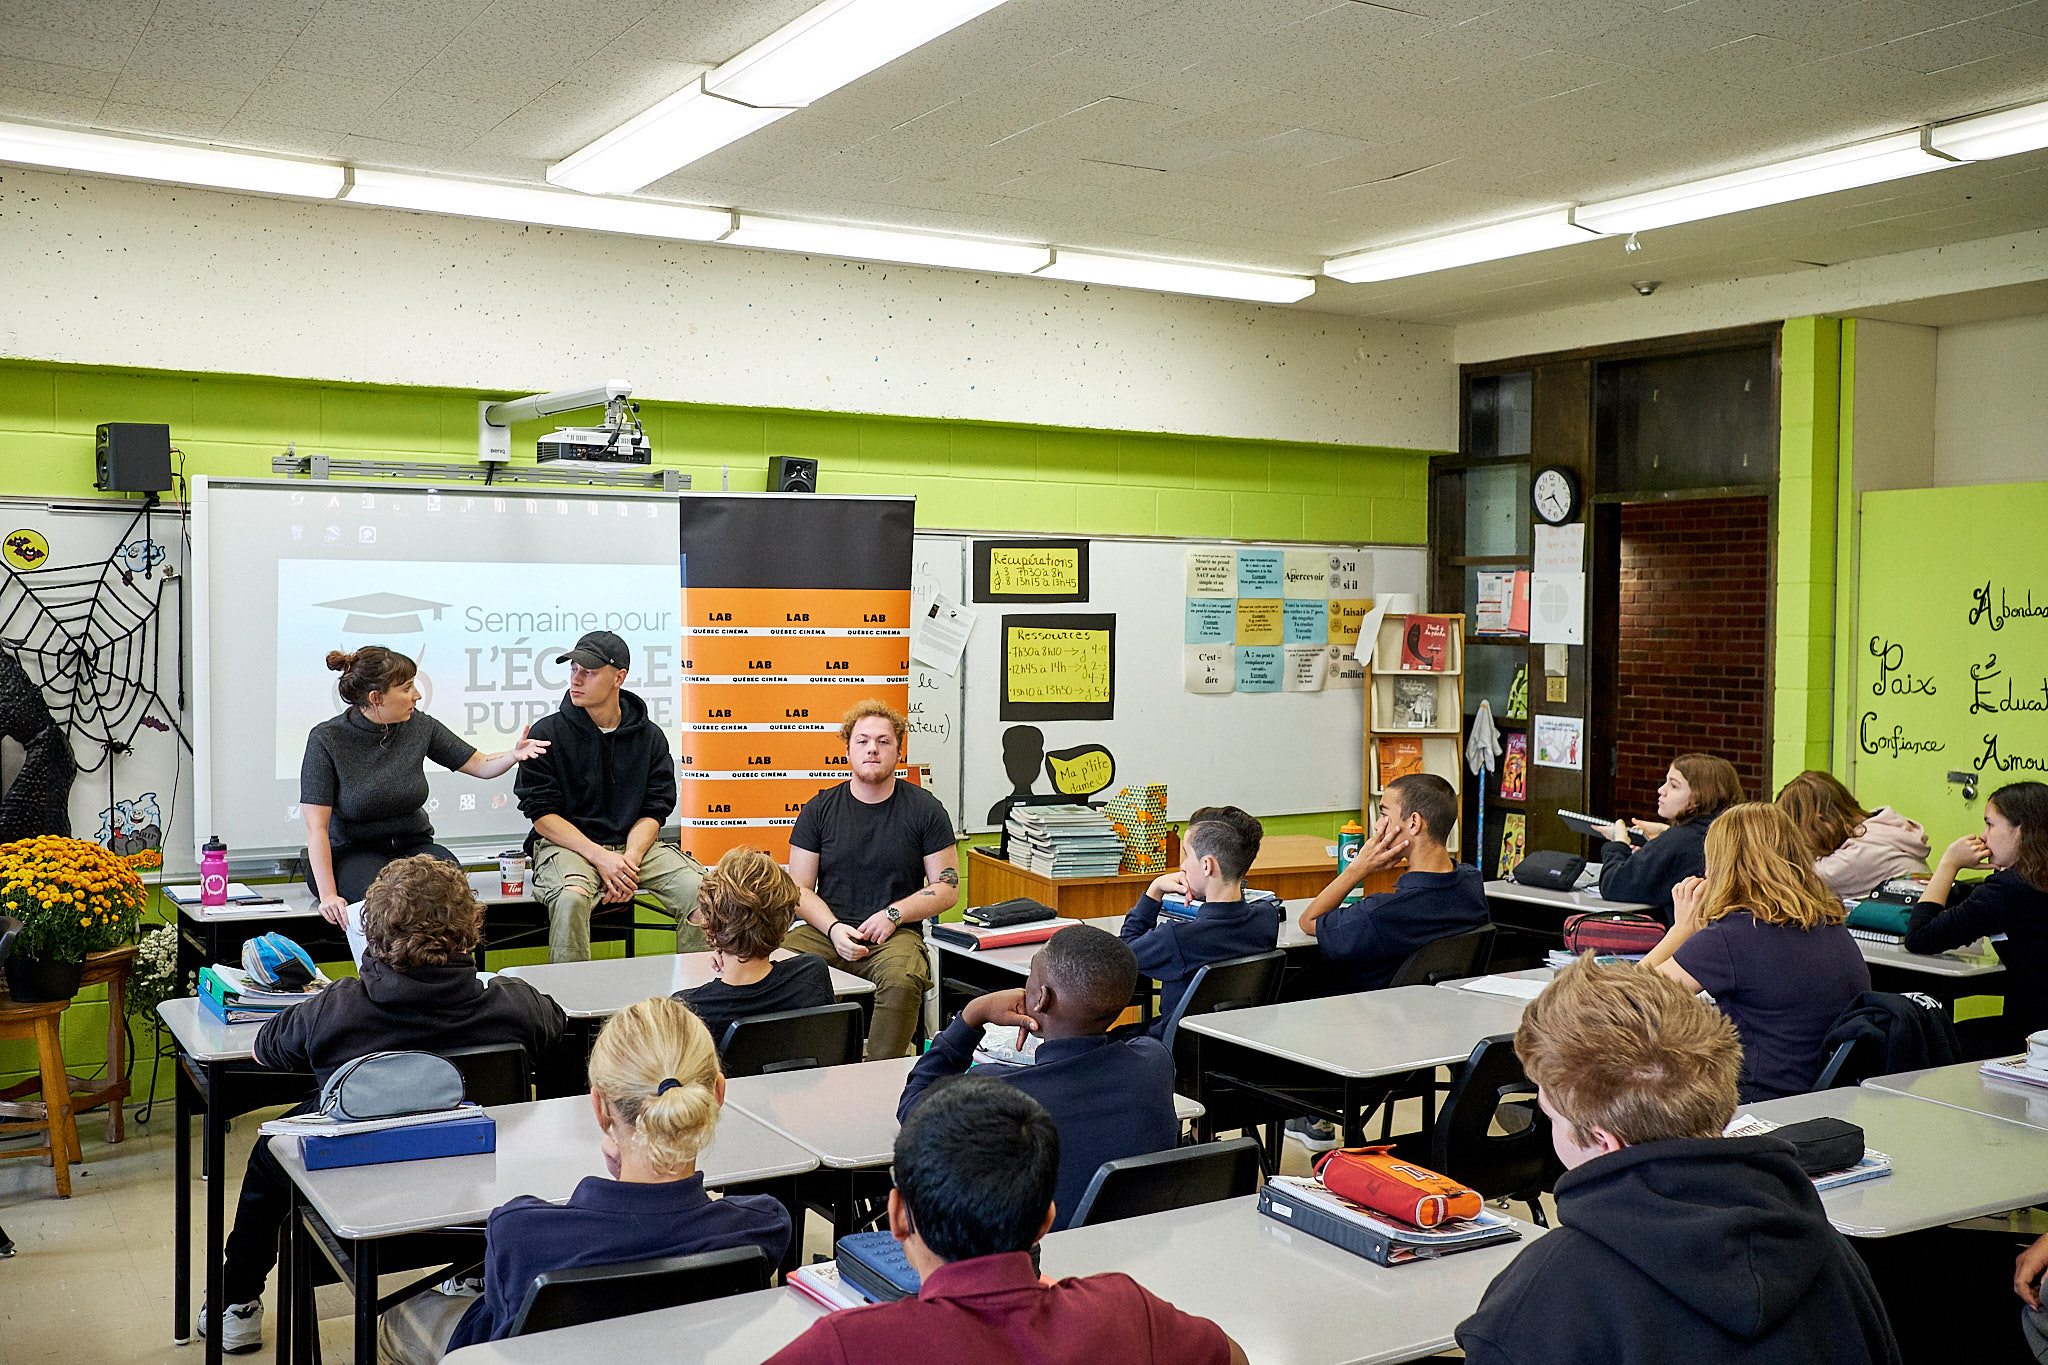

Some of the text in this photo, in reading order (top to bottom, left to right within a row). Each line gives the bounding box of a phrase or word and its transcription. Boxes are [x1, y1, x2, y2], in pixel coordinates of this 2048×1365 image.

[994, 552, 1073, 569] Récupérations
[1342, 563, 1356, 572] s'il
[1285, 572, 1324, 582] Apercevoir
[1344, 581, 1350, 590] si
[1343, 608, 1366, 616] faisait
[464, 605, 672, 633] Semaine pour
[709, 613, 732, 622] LAB
[786, 614, 810, 622] LAB
[863, 614, 886, 622] LAB
[1018, 629, 1090, 640] Ressources
[464, 637, 672, 692] L'ÉCE
[748, 661, 772, 669] LAB
[826, 662, 849, 670] LAB
[1870, 636, 1936, 695] Paix
[708, 710, 732, 718] LAB
[786, 709, 809, 718] LAB
[1860, 712, 1945, 758] Confiance
[748, 756, 772, 764] LAB
[825, 756, 848, 764] LAB
[1060, 767, 1077, 780] Ma
[1070, 780, 1095, 794] dame
